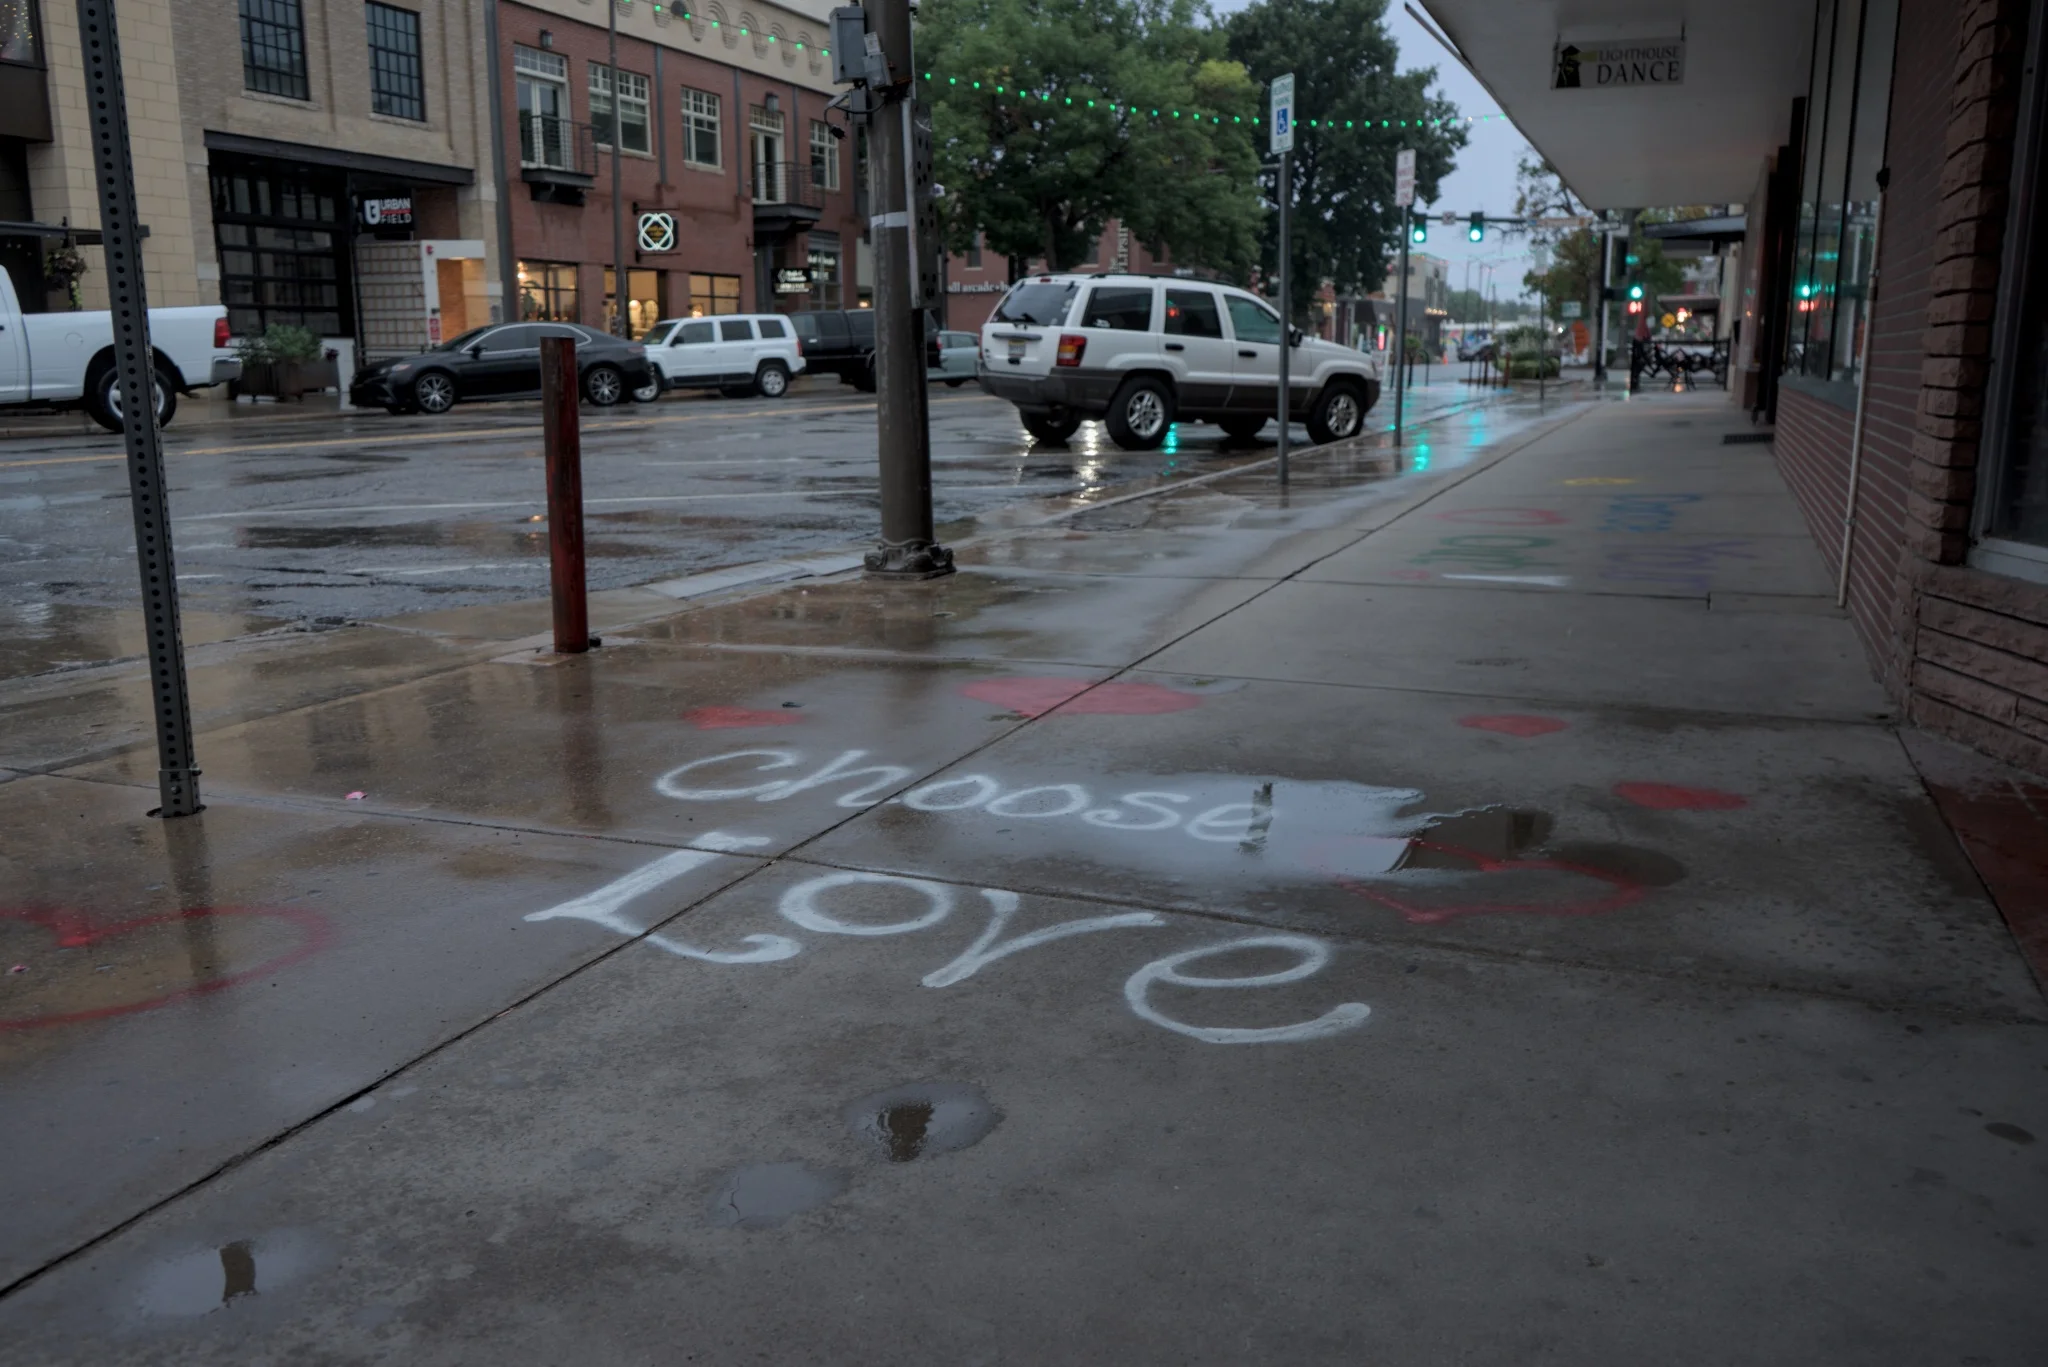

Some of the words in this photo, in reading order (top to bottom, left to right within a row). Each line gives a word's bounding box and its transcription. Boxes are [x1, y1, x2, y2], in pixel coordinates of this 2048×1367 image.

[1598, 45, 1681, 62] LIGHTHOUSE
[1596, 60, 1680, 85] DANCE
[380, 197, 412, 209] URBAN
[380, 213, 412, 225] FIELD
[655, 748, 1266, 844] Choose
[522, 830, 1372, 1044] Love
